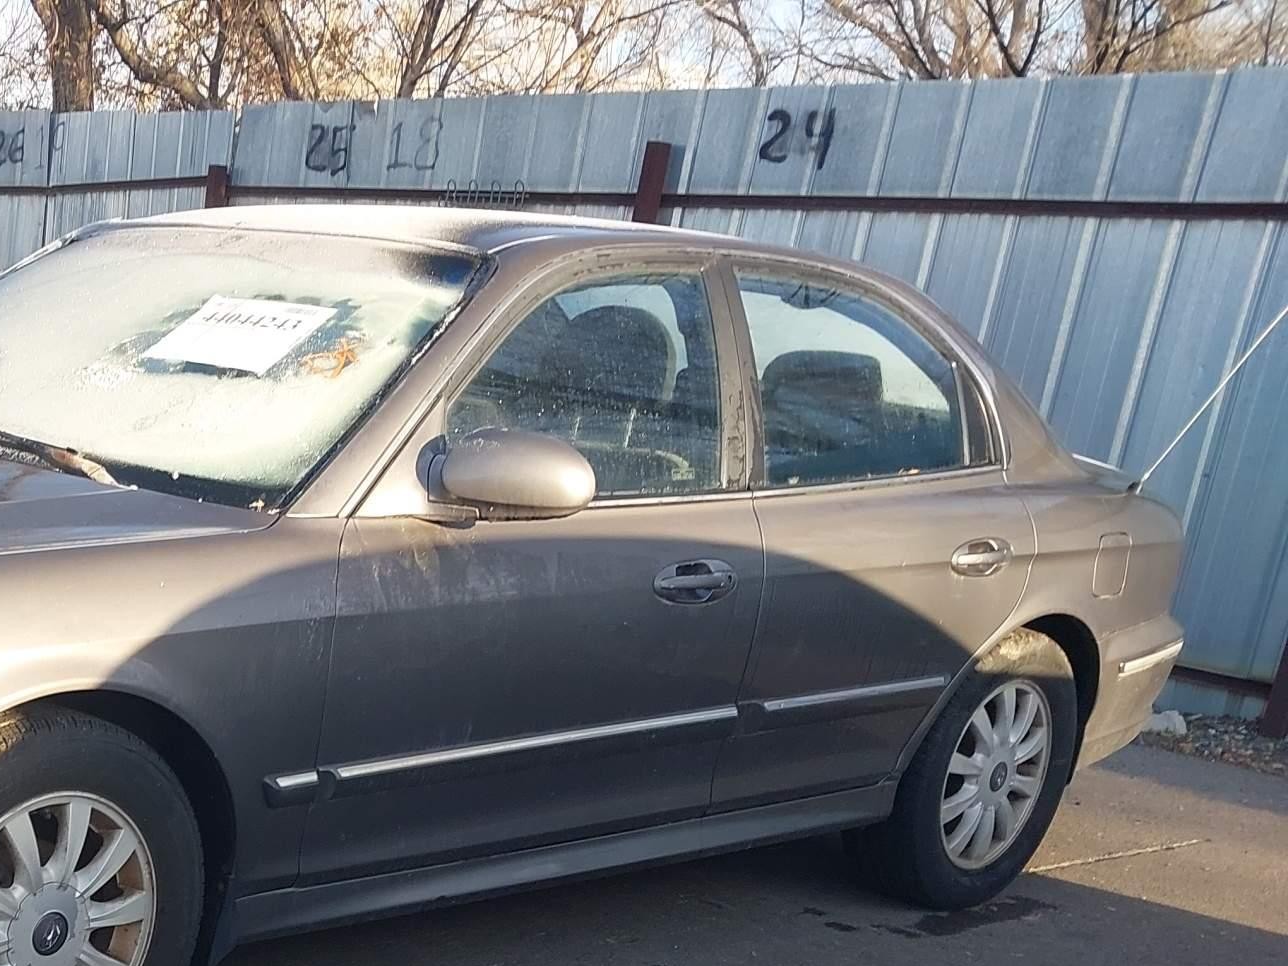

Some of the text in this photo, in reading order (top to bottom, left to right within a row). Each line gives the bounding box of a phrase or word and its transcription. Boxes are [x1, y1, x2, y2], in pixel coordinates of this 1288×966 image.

[305, 115, 443, 177] 25 18
[759, 108, 836, 170] 24
